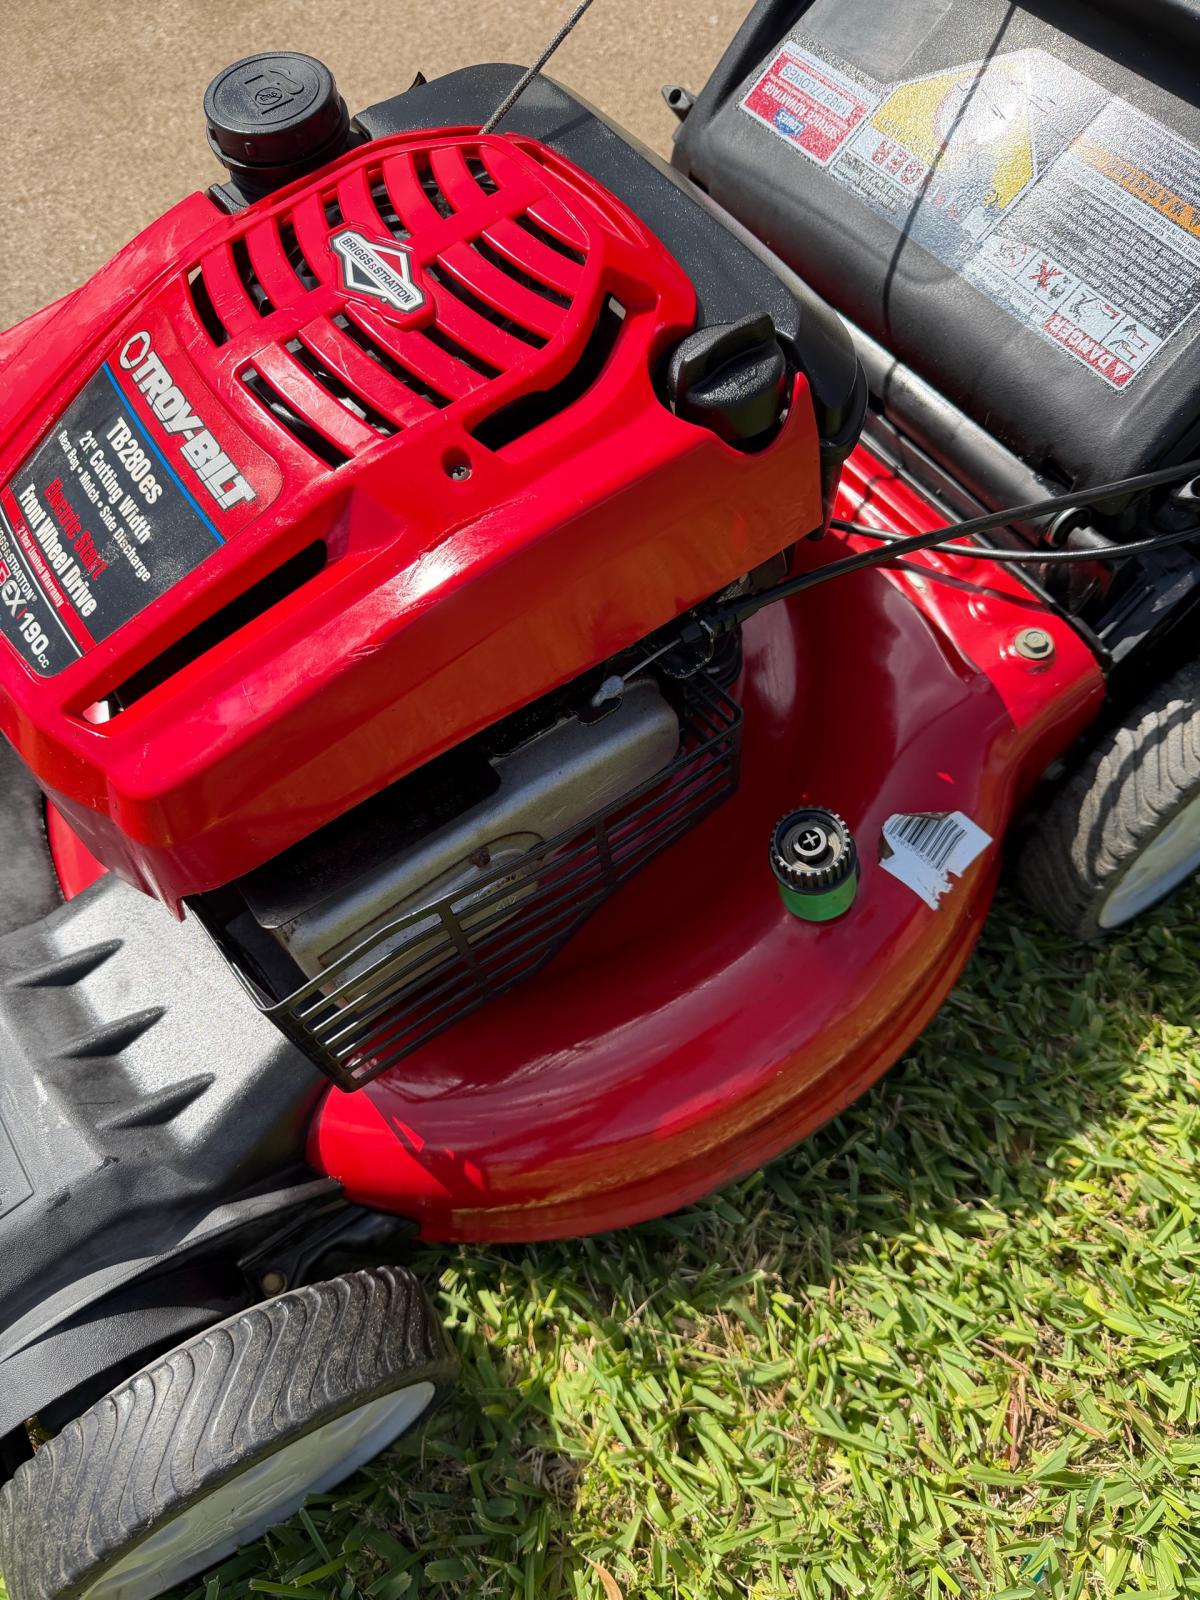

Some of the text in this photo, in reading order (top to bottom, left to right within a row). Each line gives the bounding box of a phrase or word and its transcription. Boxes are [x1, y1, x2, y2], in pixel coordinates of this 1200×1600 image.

[760, 79, 808, 118] ADVANTAGE
[1046, 314, 1116, 370] DANGER
[130, 350, 257, 512] TROY-BILT
[44, 477, 108, 581] Electric Start
[58, 430, 151, 582] Rear Bag Mulch Side Discharge
[90, 450, 124, 505] Cutting
[118, 494, 152, 544] Width
[18, 483, 98, 617] Front Wheel Drive
[18, 526, 65, 608] 2 Year Limited Warranty
